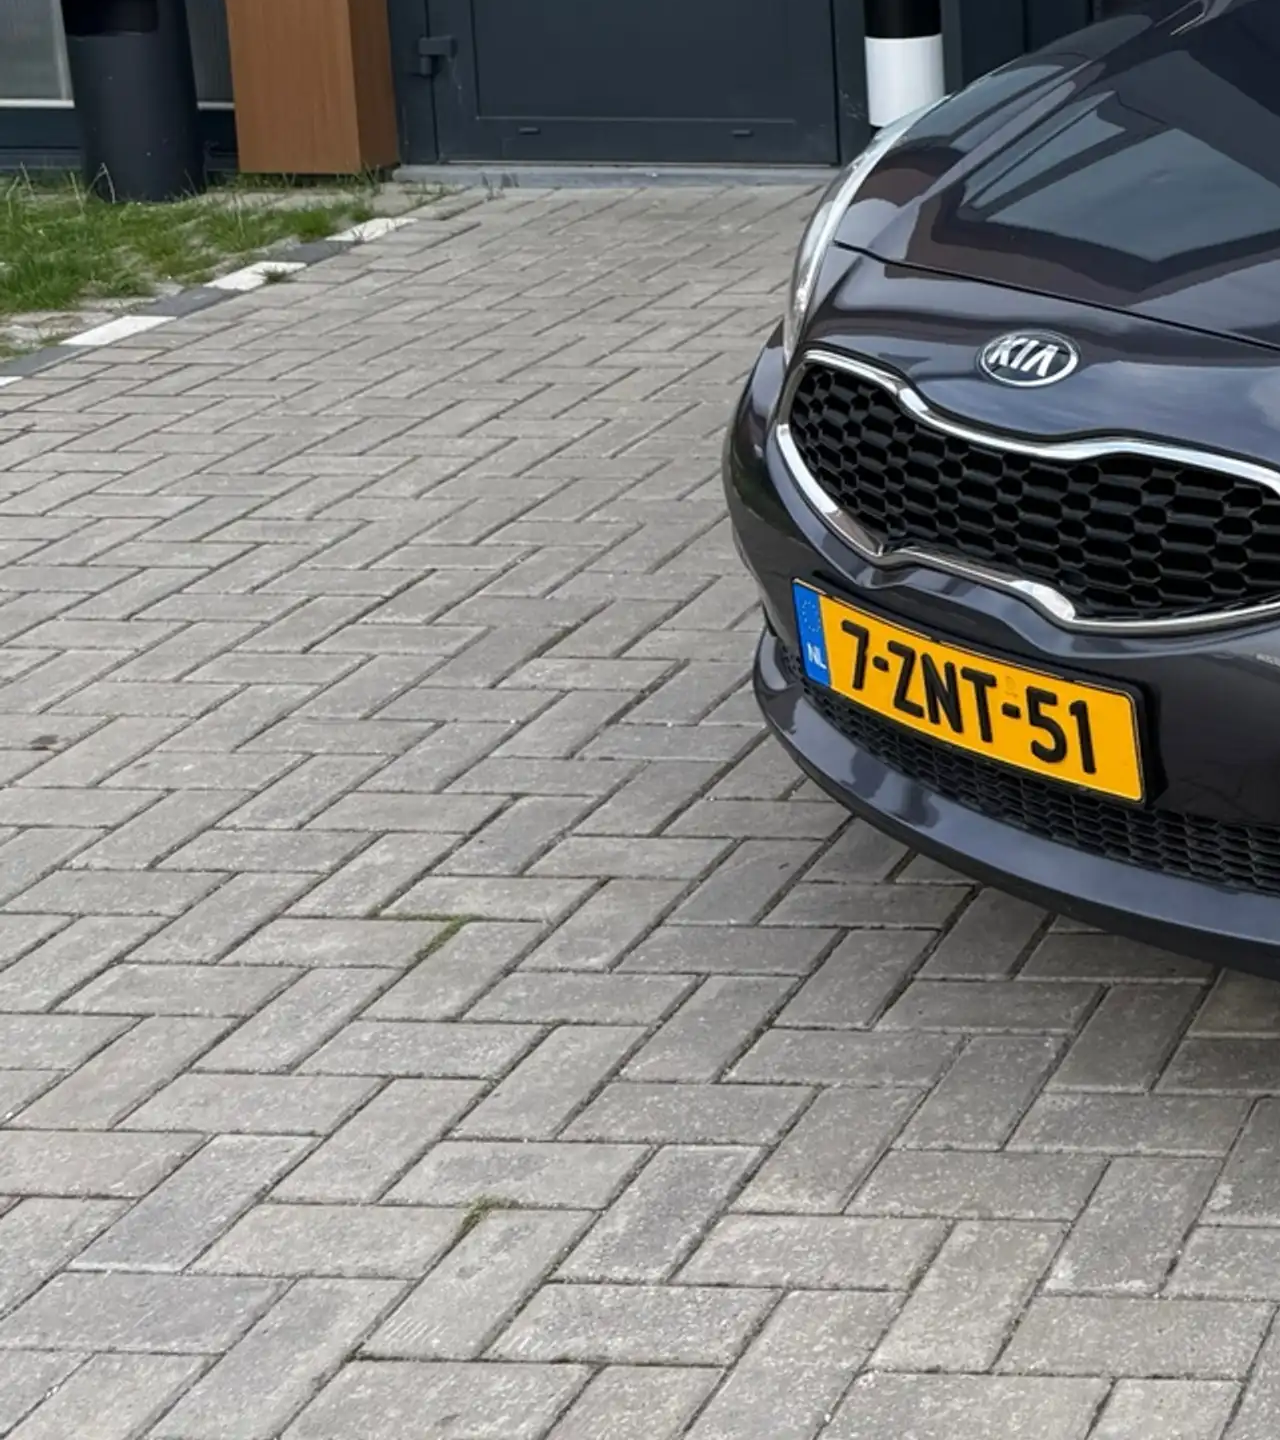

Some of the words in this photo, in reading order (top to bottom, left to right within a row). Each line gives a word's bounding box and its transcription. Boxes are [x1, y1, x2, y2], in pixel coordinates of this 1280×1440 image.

[987, 336, 1060, 378] KIA
[806, 641, 828, 671] NL
[840, 618, 1098, 775] 7-ZNT-51
